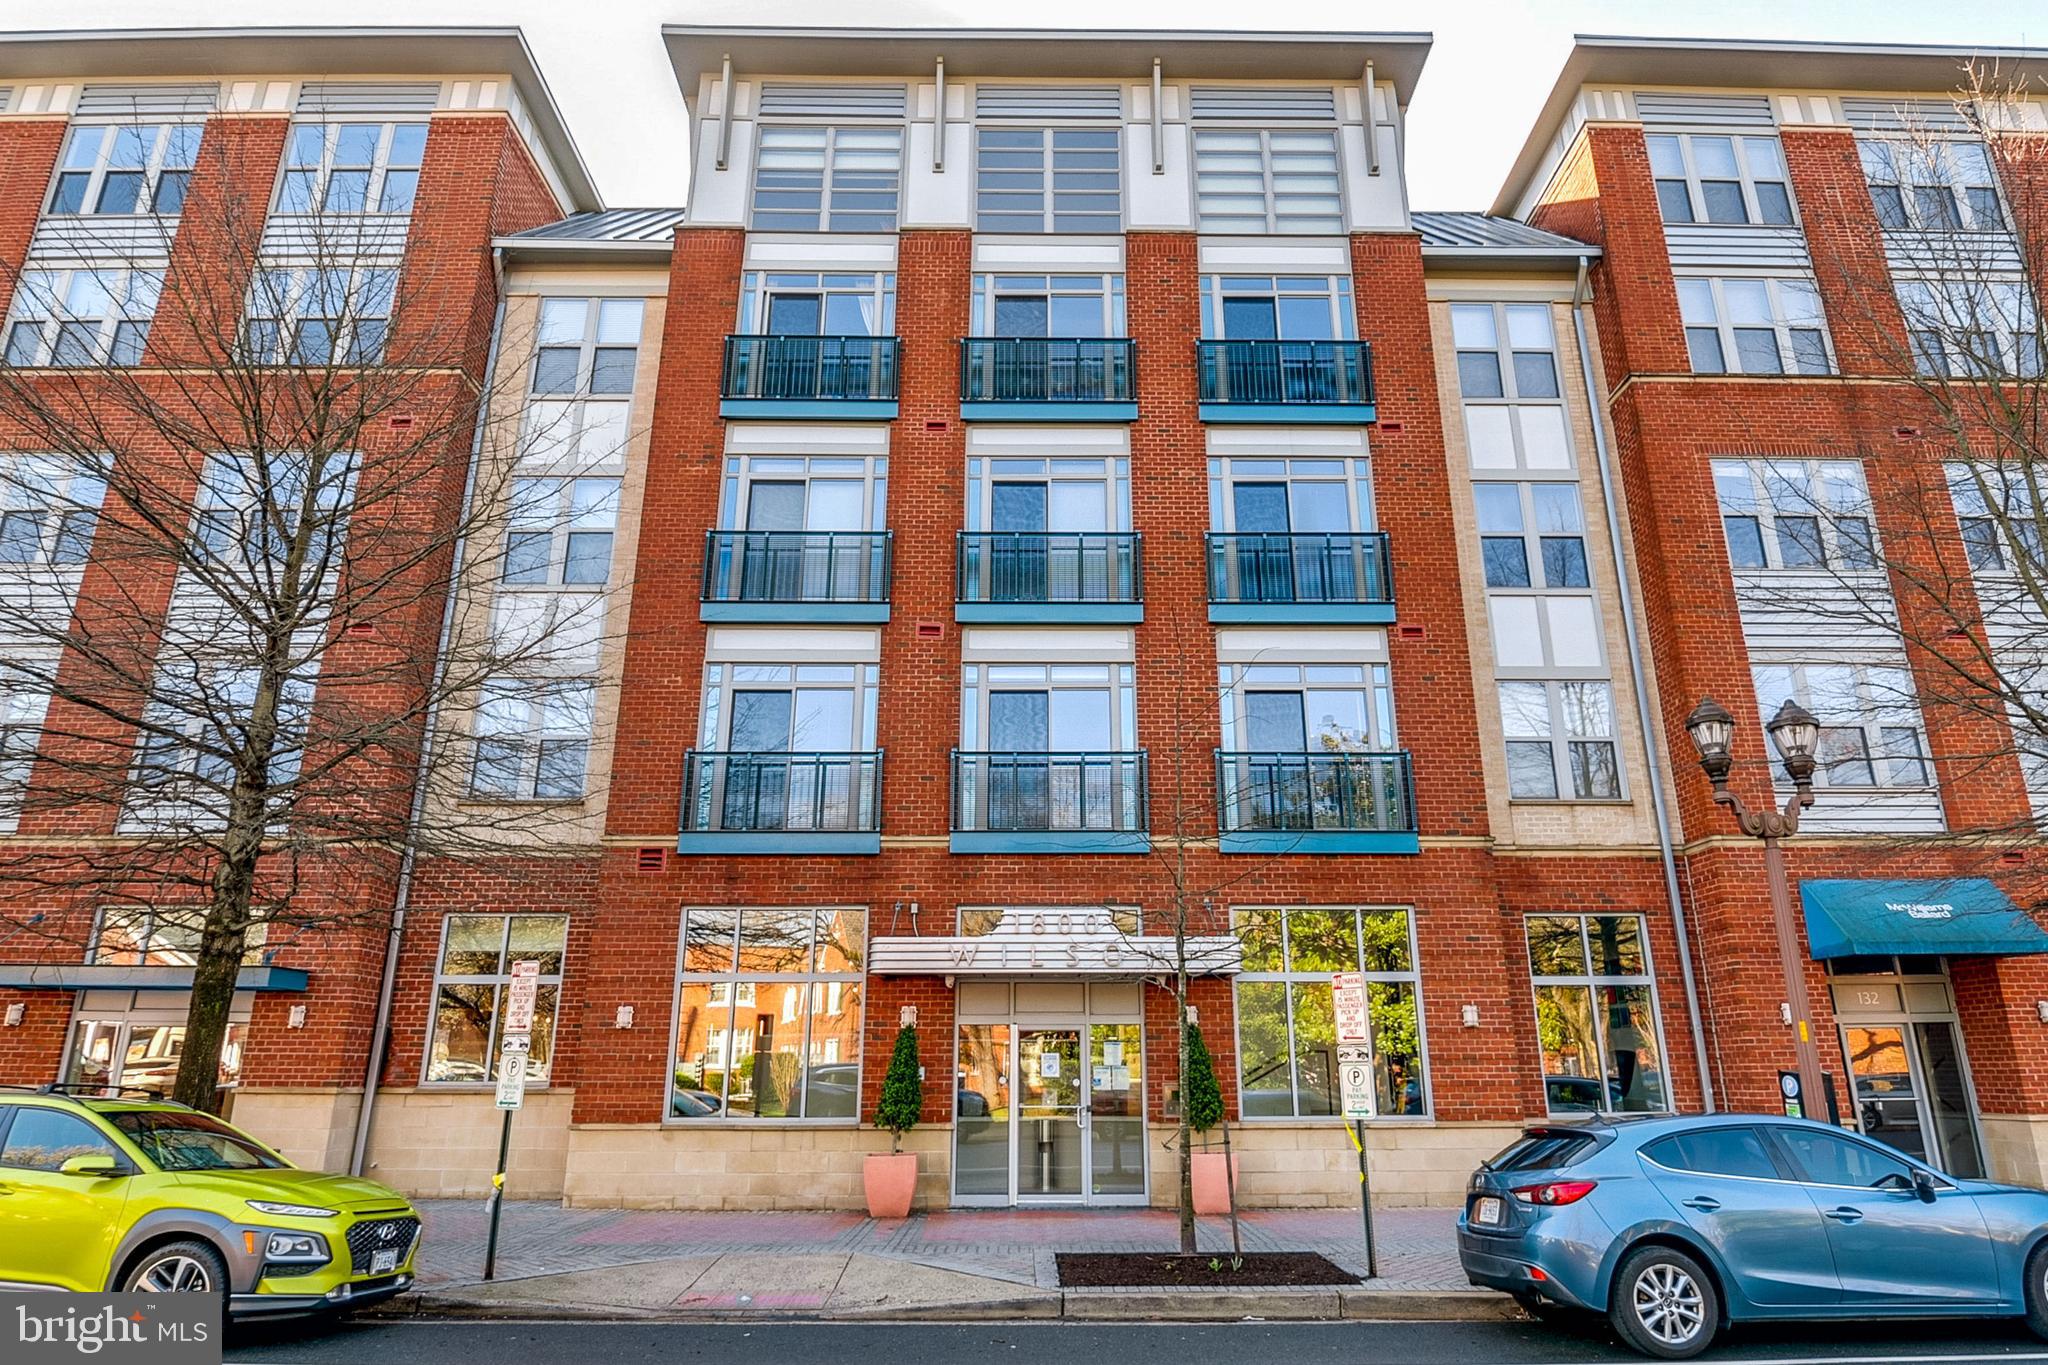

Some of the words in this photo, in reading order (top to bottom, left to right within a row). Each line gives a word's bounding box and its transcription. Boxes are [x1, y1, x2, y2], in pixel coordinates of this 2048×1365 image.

[1010, 912, 1101, 935] 1800
[949, 943, 1166, 968] WILSON
[1856, 992, 1880, 1005] 132
[510, 1060, 518, 1074] P
[1353, 1070, 1360, 1084] P
